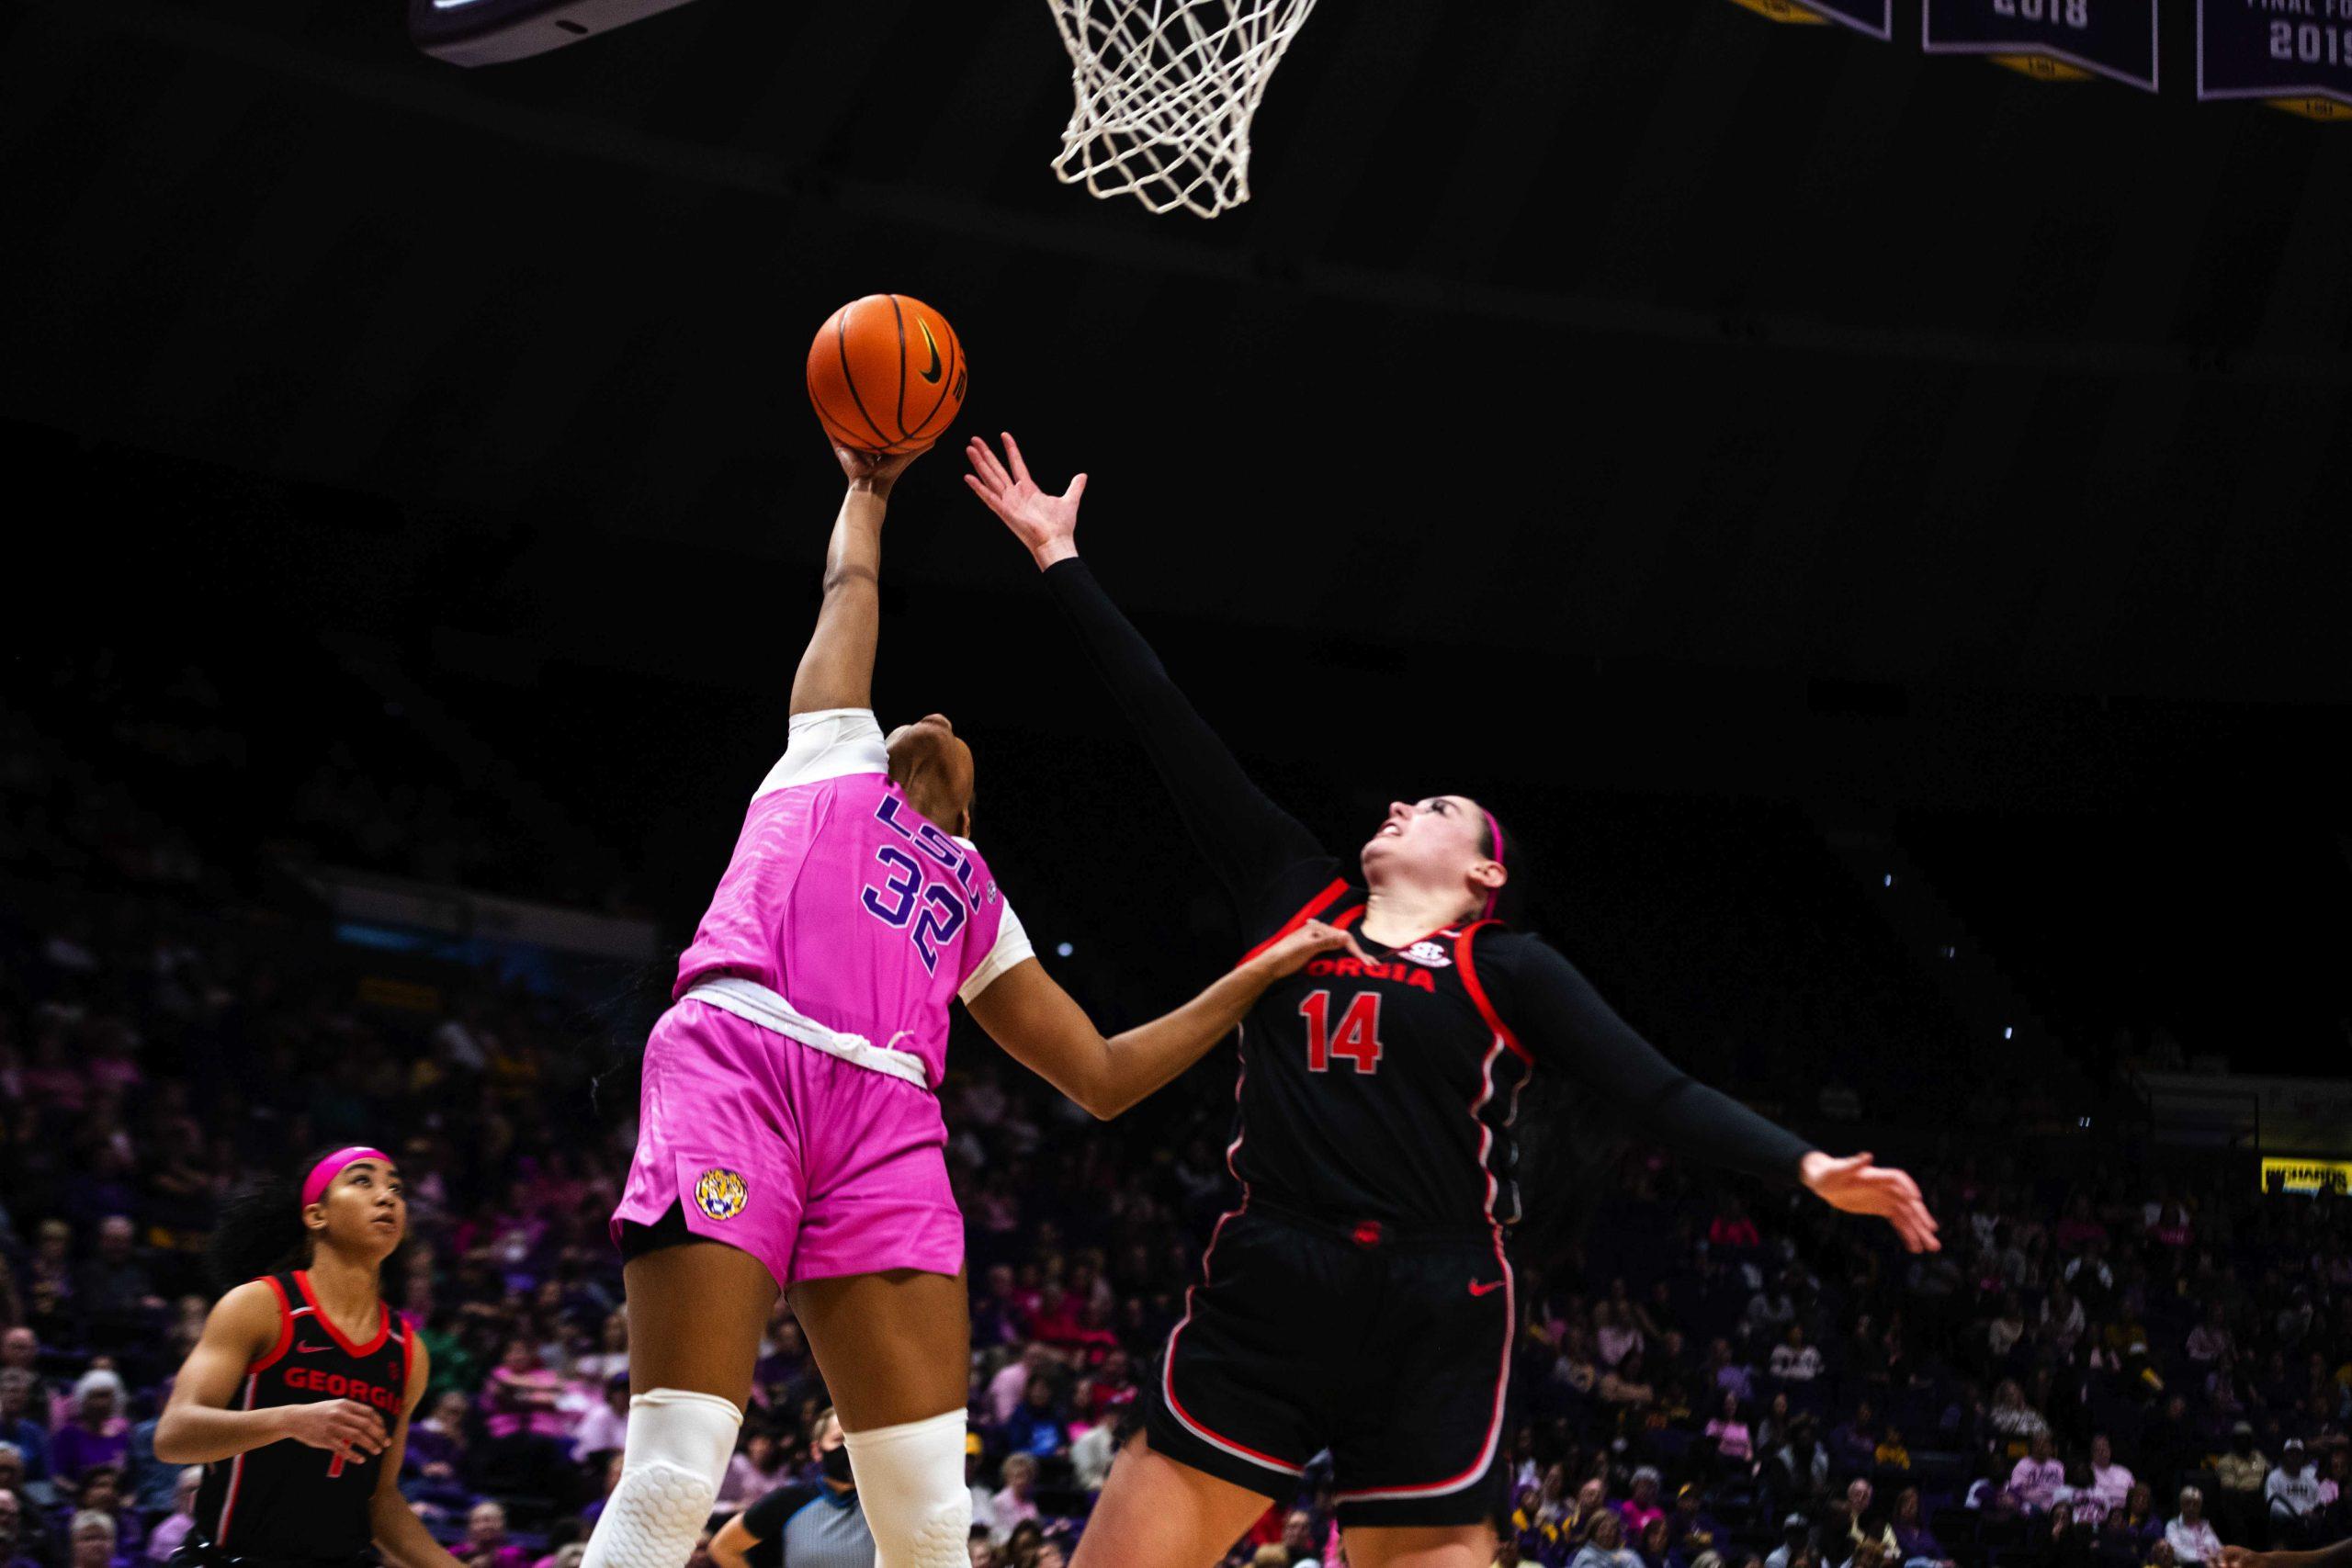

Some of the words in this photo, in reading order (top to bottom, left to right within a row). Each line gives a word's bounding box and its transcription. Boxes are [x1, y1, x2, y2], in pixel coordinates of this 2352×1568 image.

[861, 844, 967, 980] 32
[1306, 956, 1436, 994] ORGIA
[1298, 988, 1384, 1076] 14
